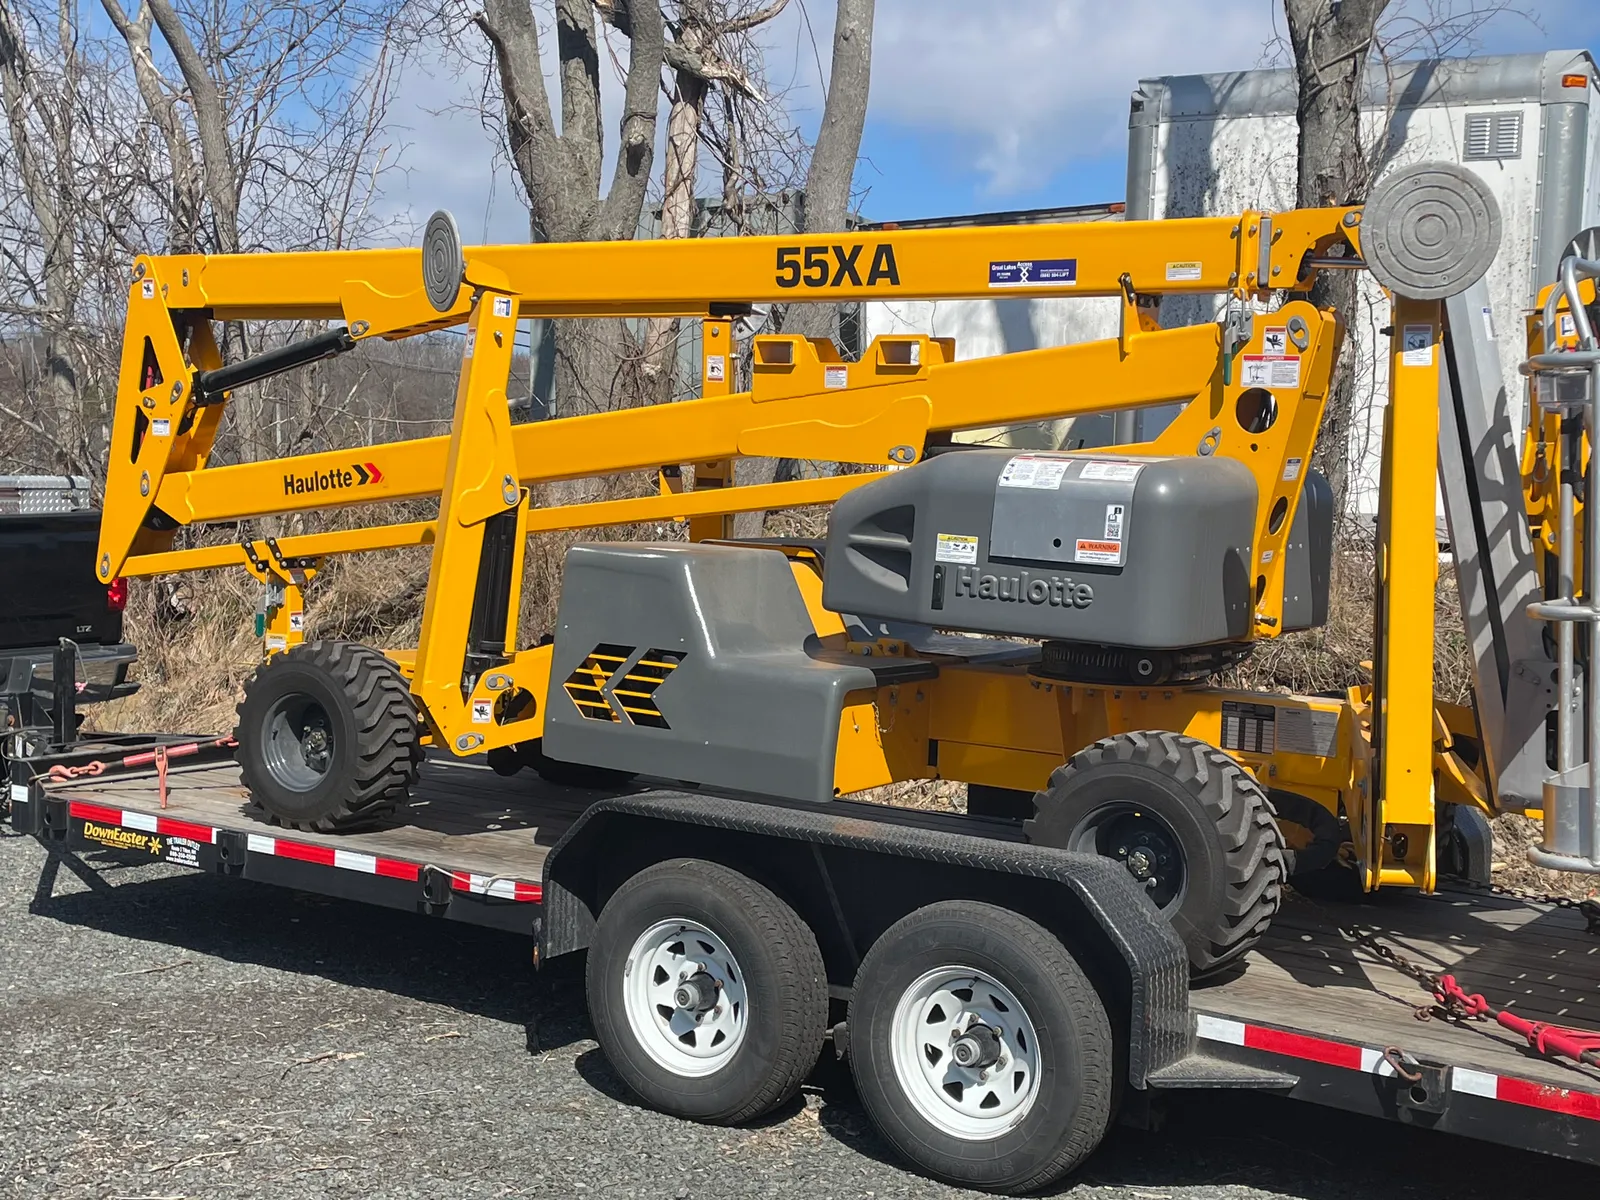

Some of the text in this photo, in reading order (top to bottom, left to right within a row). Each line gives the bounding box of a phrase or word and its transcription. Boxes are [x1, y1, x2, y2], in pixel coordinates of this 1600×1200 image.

[775, 244, 901, 288] 55XA
[283, 468, 353, 496] Haulotte
[1088, 543, 1118, 551] WARNING
[955, 565, 1095, 609] Haulotte
[76, 625, 92, 633] LTZ
[83, 821, 149, 847] DownEaster
